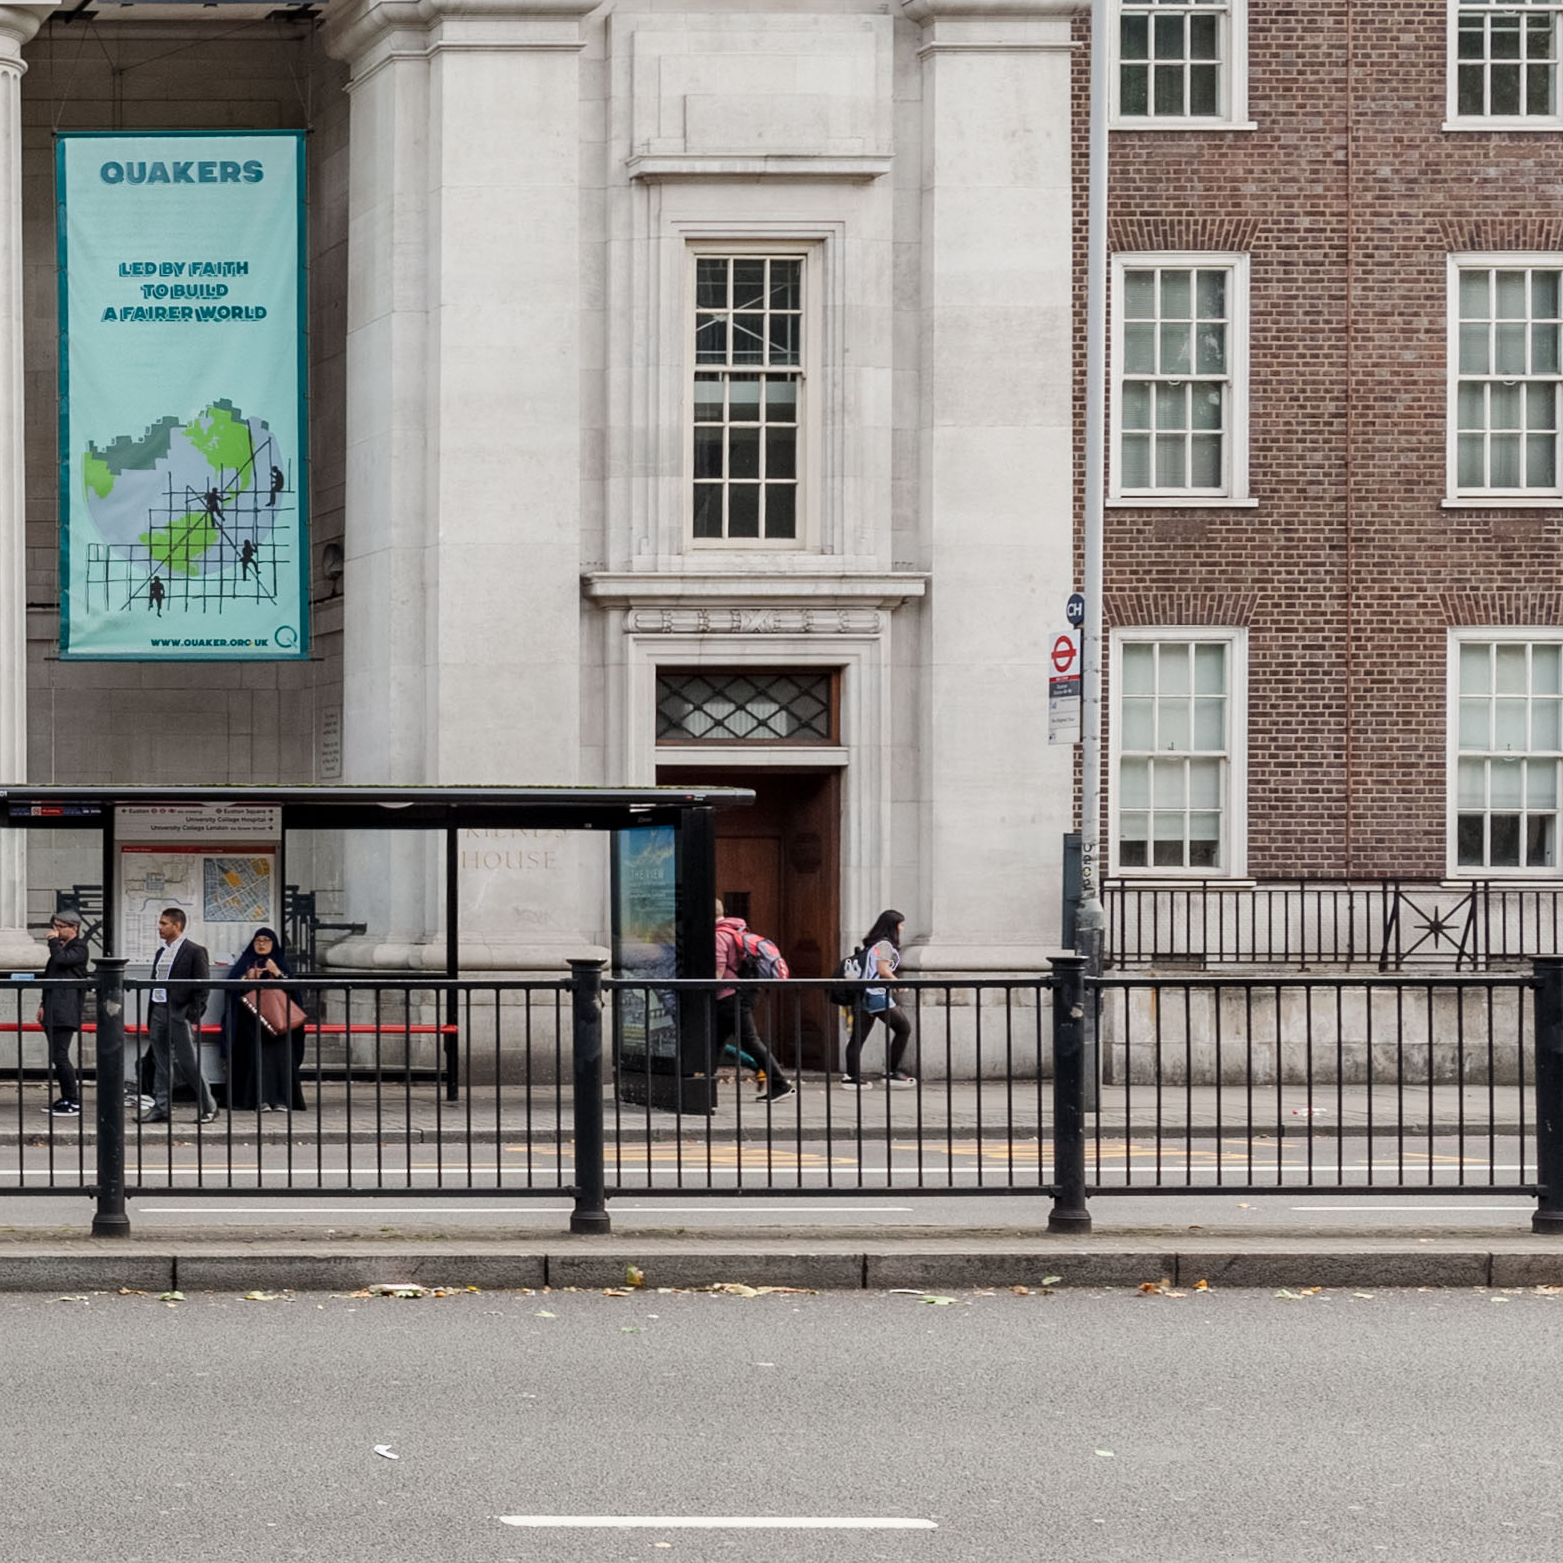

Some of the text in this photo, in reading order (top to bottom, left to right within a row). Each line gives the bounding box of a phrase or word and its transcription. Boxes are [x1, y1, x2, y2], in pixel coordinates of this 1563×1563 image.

[100, 160, 264, 184] QUAKERS
[119, 261, 249, 277] LED BY FAITH
[140, 283, 229, 299] TO BUILD
[101, 306, 267, 322] A FAIRER WORLD
[1067, 603, 1082, 617] CH
[461, 851, 557, 870] HOUSE
